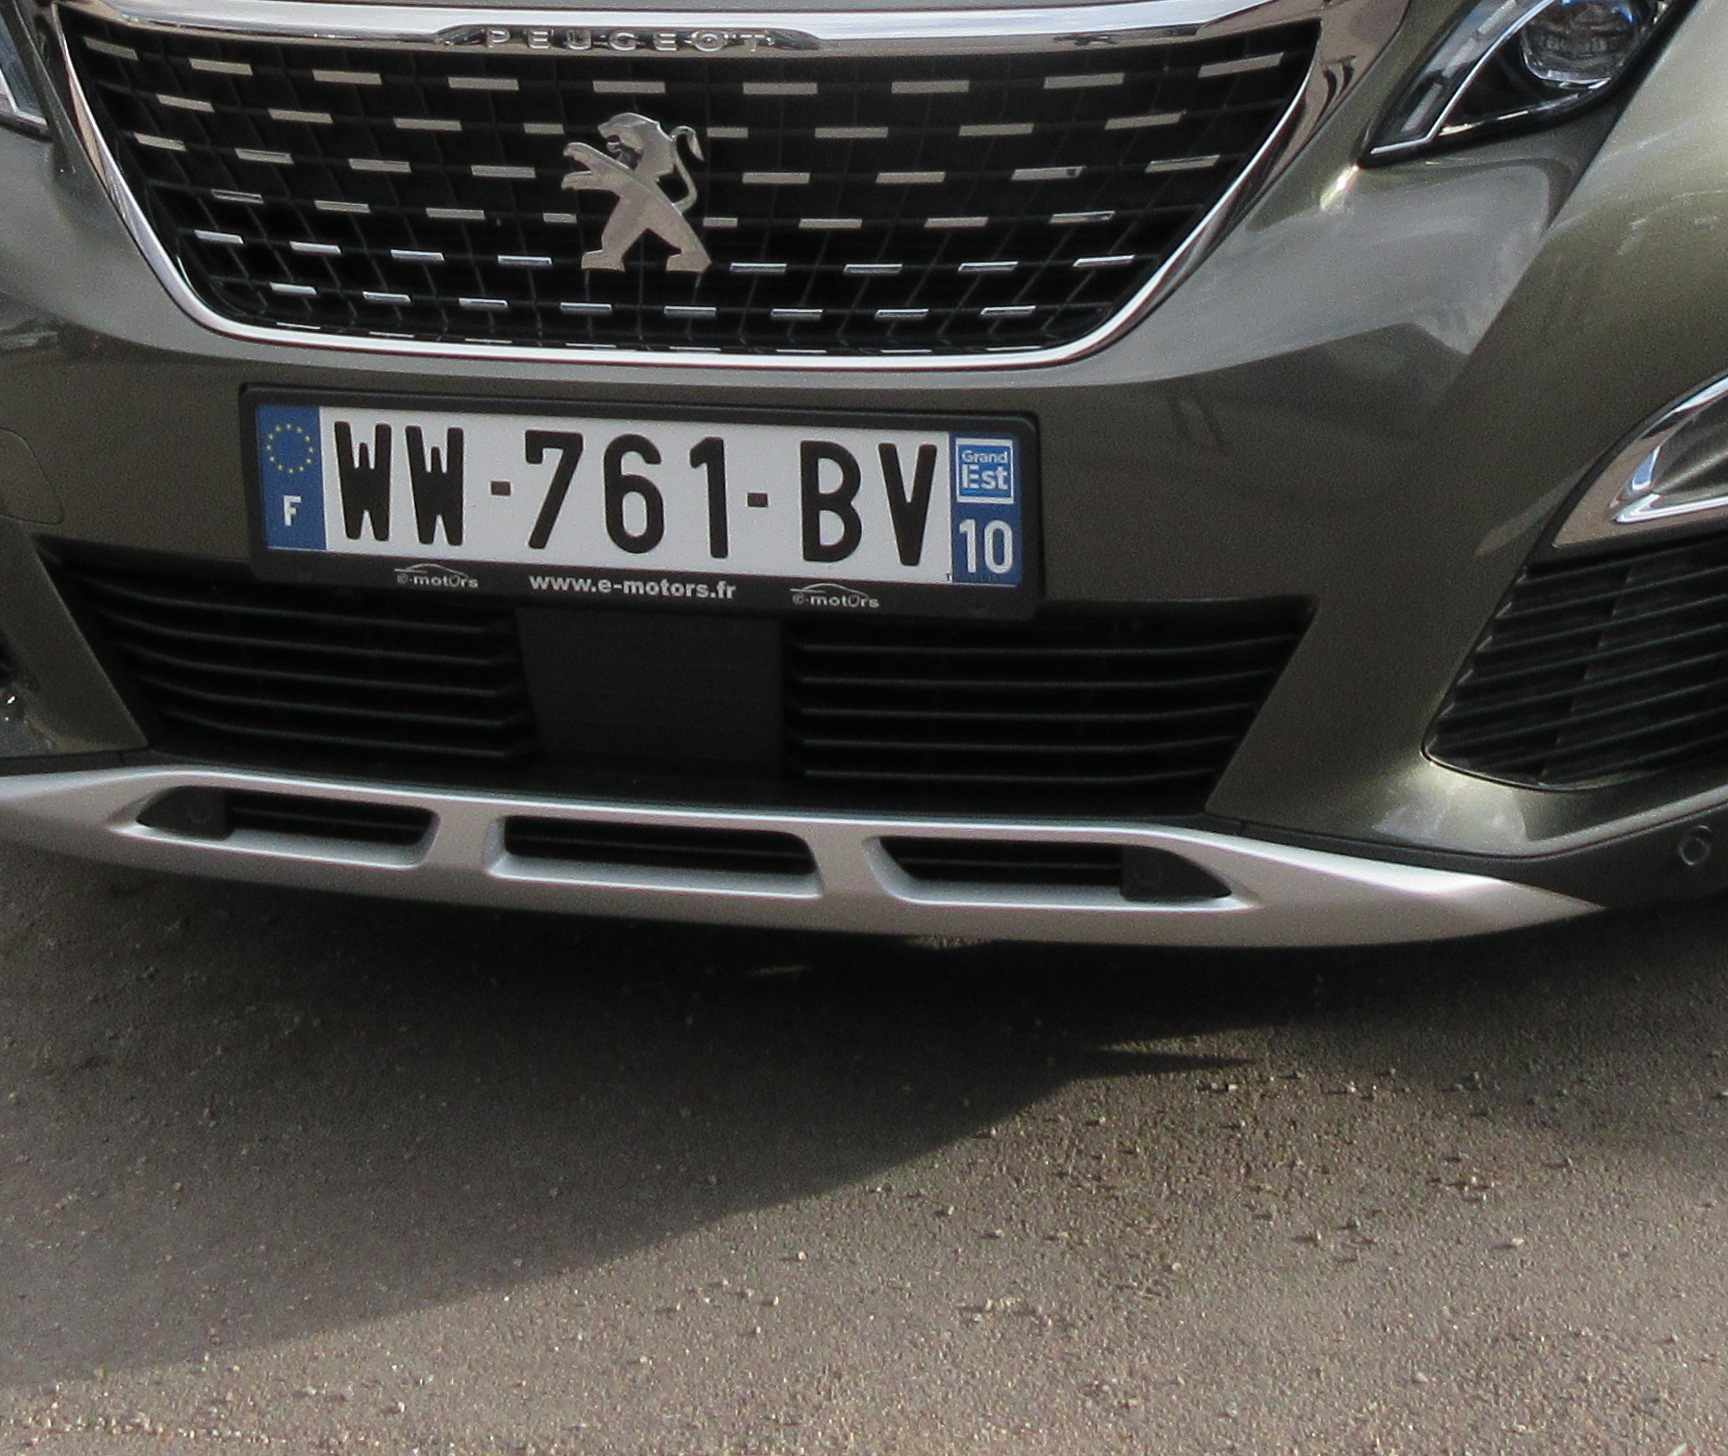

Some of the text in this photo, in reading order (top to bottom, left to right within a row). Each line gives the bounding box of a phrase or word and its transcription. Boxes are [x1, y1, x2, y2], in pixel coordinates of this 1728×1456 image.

[486, 28, 774, 52] PEUGEOT
[962, 450, 1008, 463] Grand
[961, 464, 1009, 490] Est
[283, 495, 301, 526] F
[959, 518, 1013, 574] 10
[529, 575, 736, 599] www.e-motors.fr
